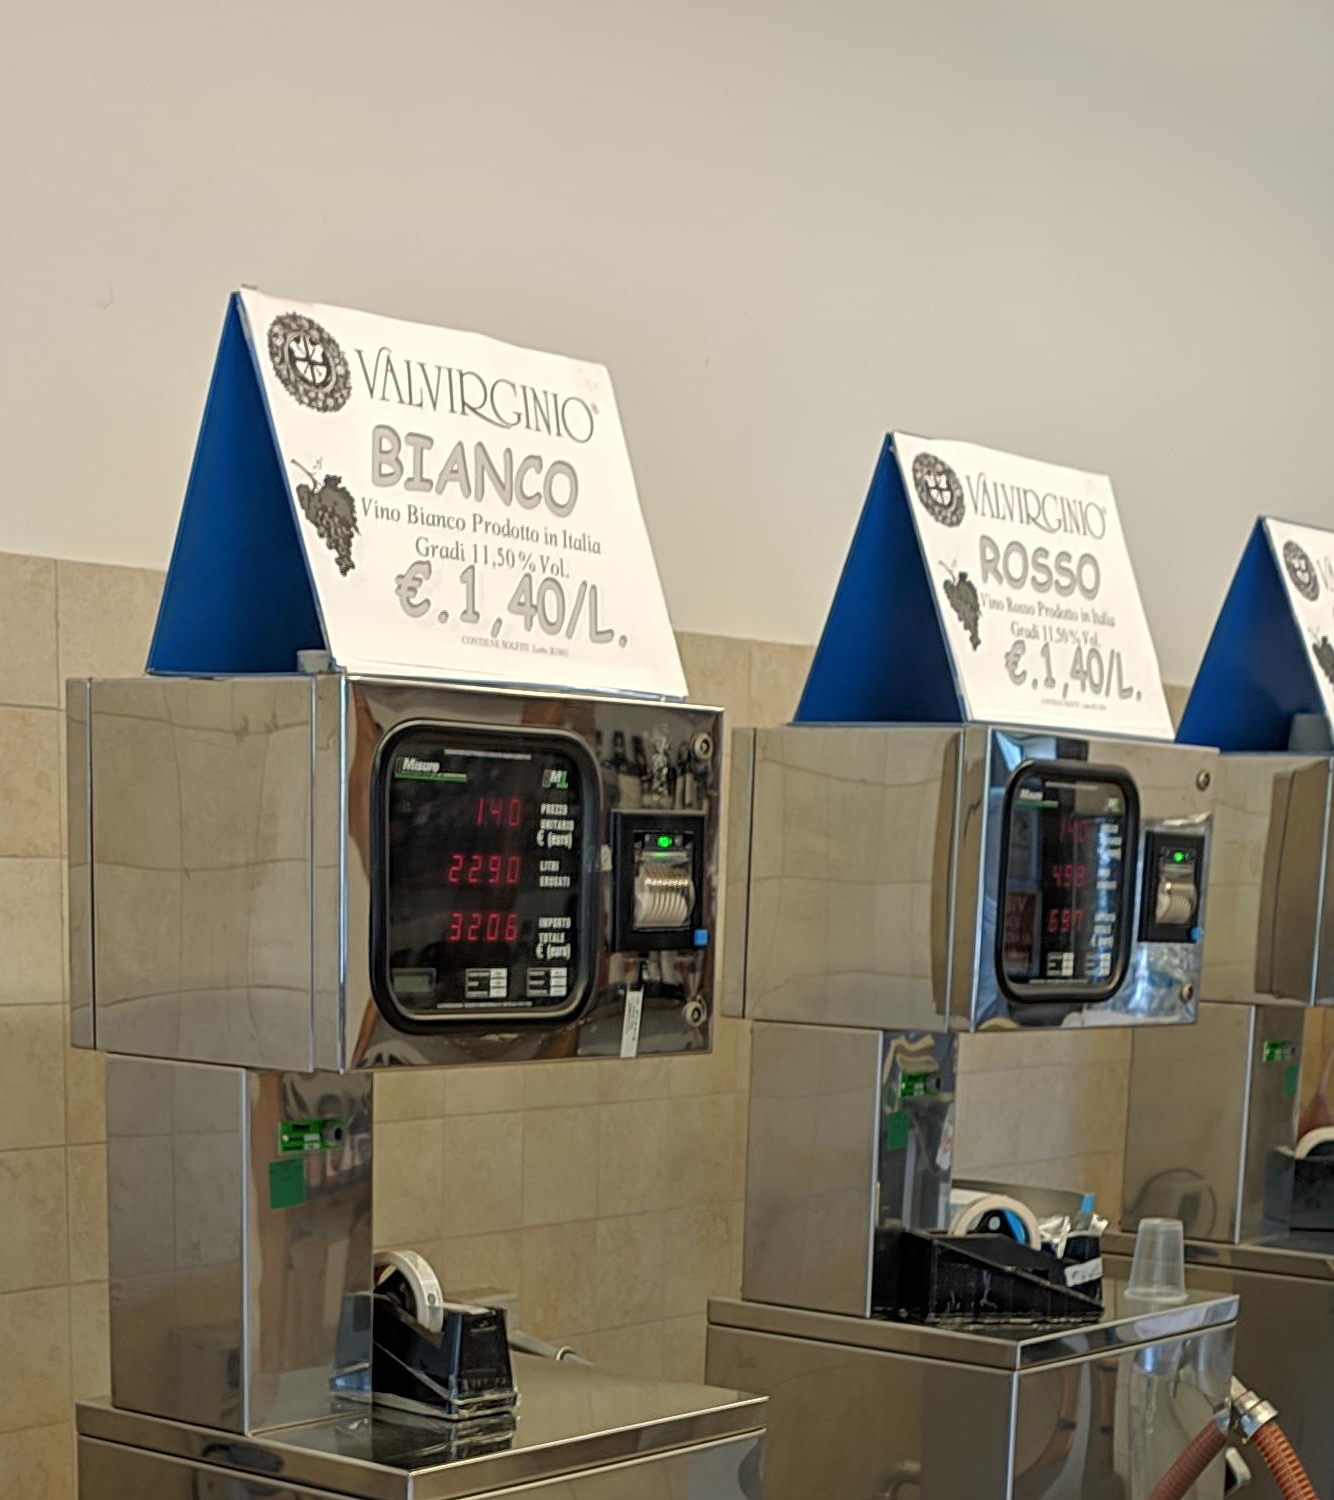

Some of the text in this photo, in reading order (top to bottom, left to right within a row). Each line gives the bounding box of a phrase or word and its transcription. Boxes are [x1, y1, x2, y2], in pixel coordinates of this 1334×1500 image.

[354, 347, 594, 443] VALVIRGINIO
[371, 424, 578, 518] BIANCO
[361, 497, 601, 554] Vino Bianco Prodotto in Italia
[966, 472, 1106, 540] VALVIRGINIO
[415, 536, 465, 562] Gradi
[979, 534, 1100, 600] ROSSO
